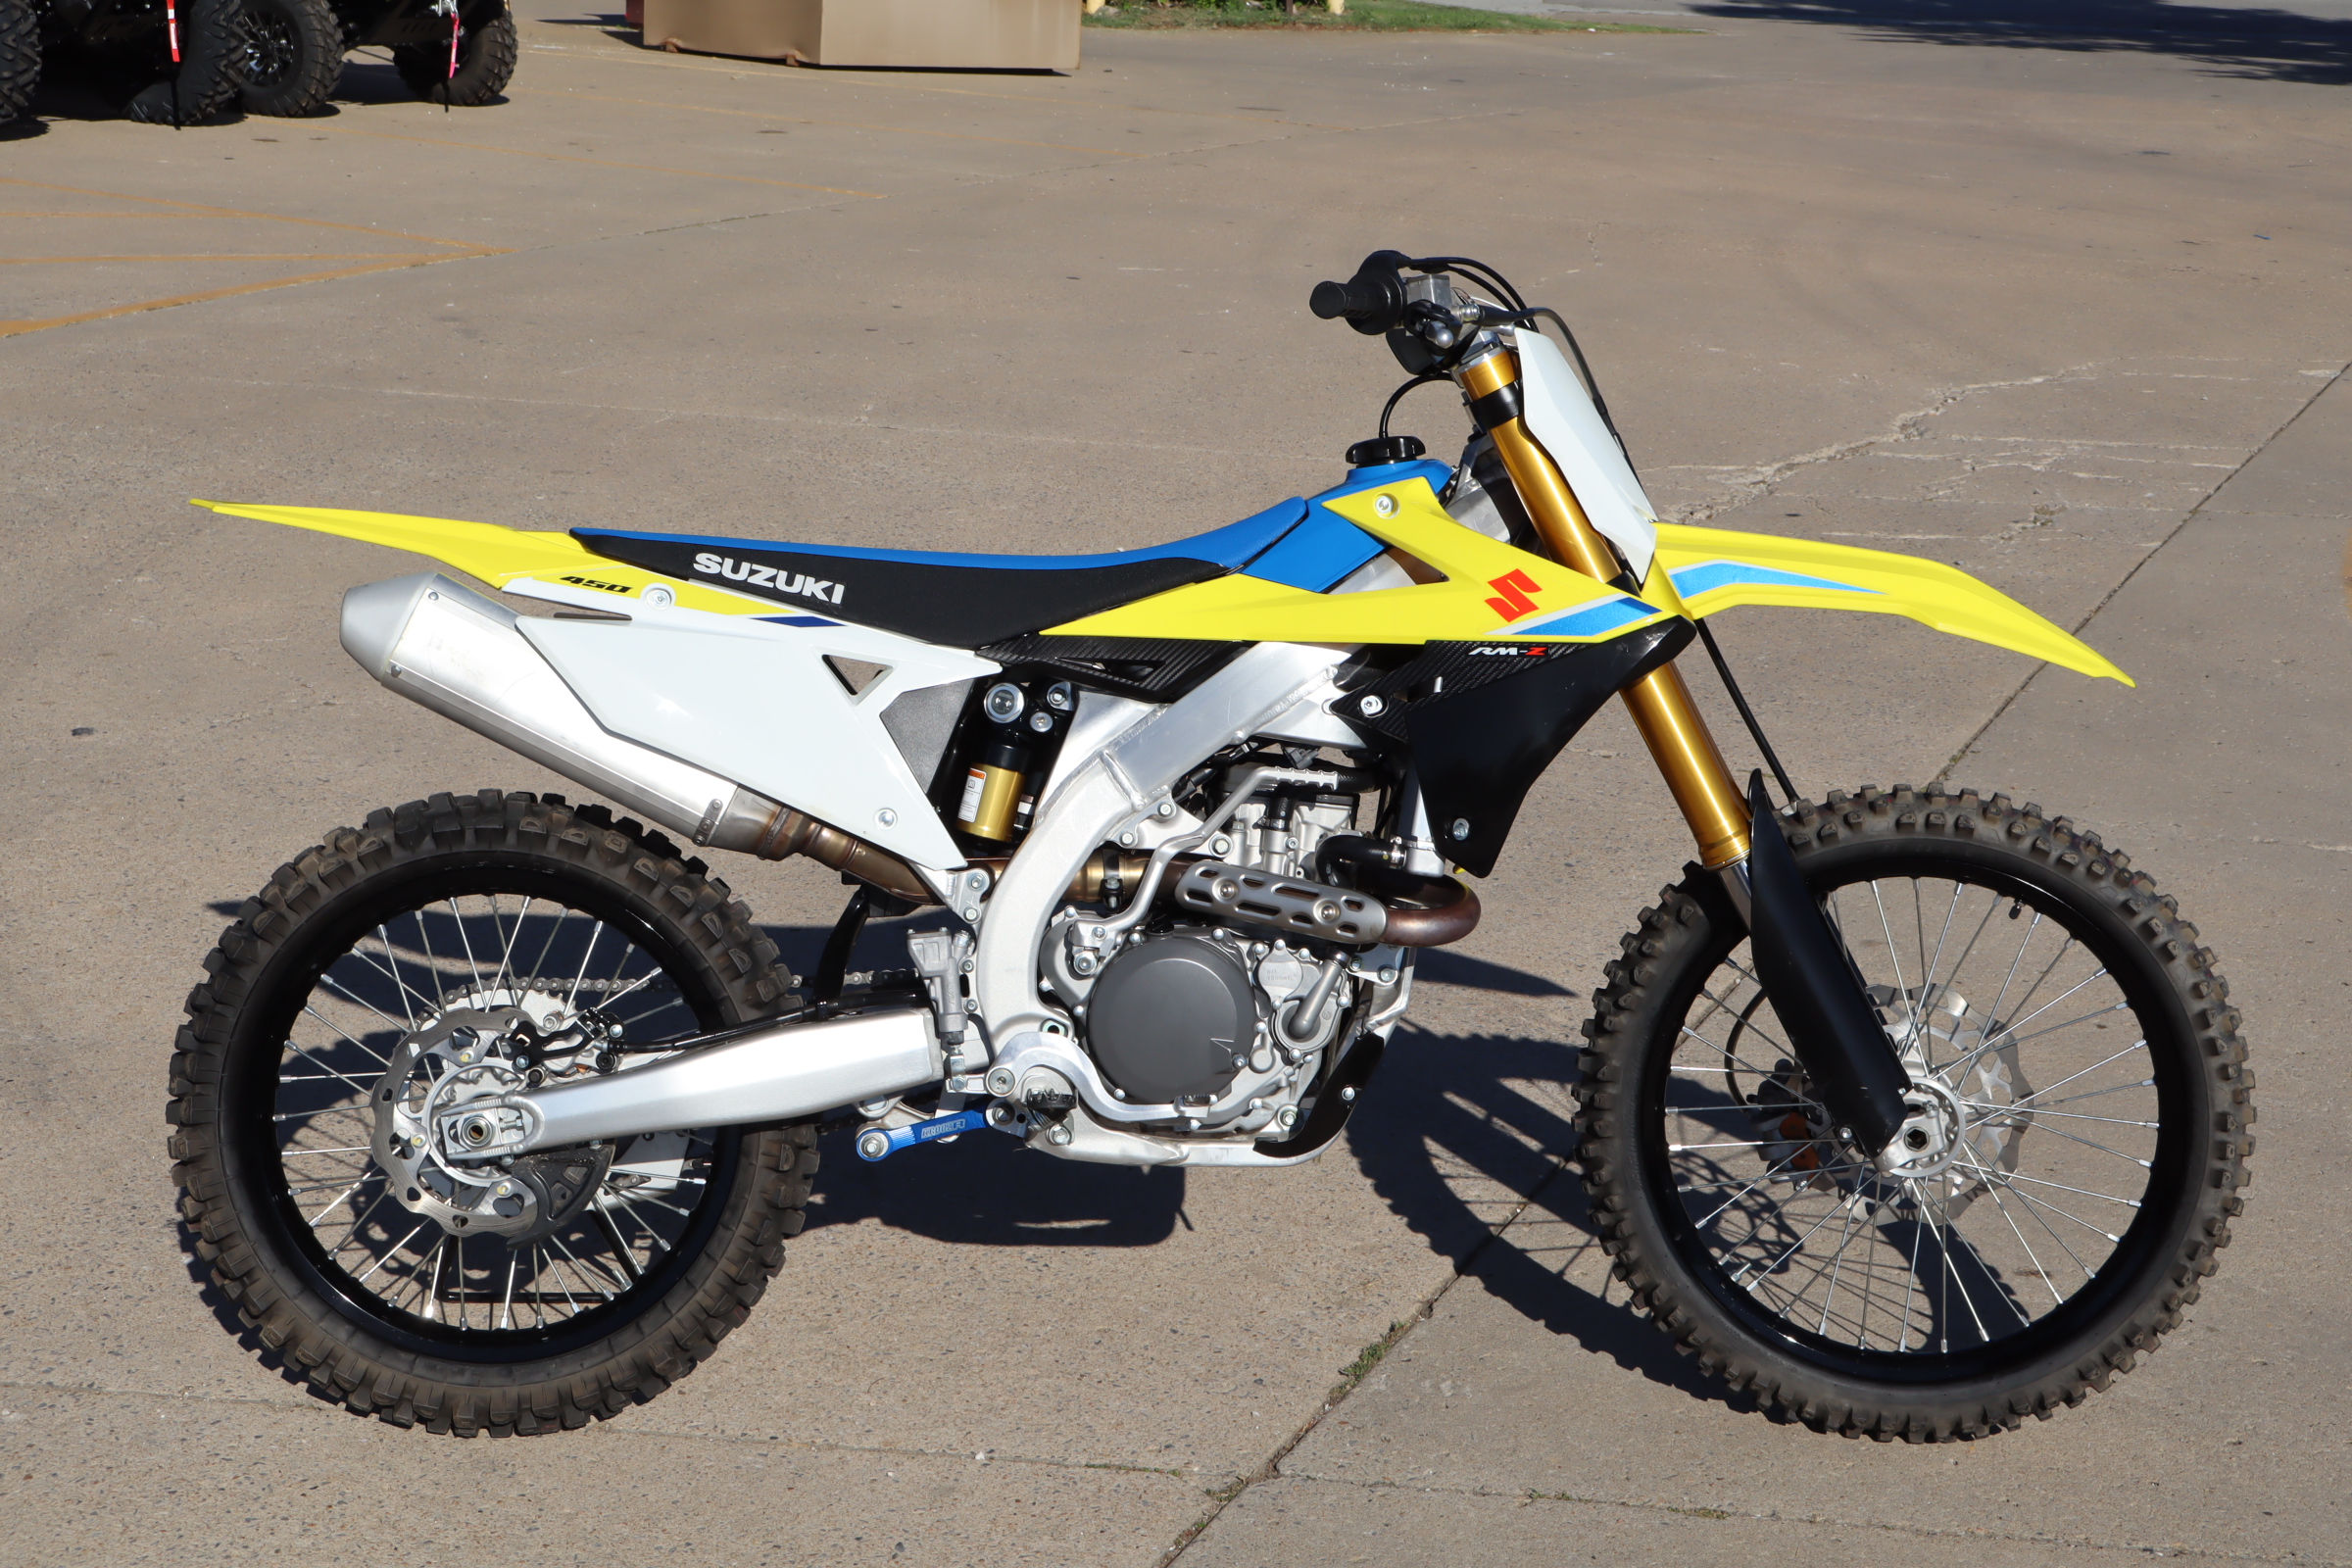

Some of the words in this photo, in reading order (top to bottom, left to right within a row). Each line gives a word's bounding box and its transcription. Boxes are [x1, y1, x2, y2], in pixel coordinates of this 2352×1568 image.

[560, 576, 633, 593] 450
[693, 553, 845, 605] SUZUKI
[1468, 647, 1548, 656] RM-Z
